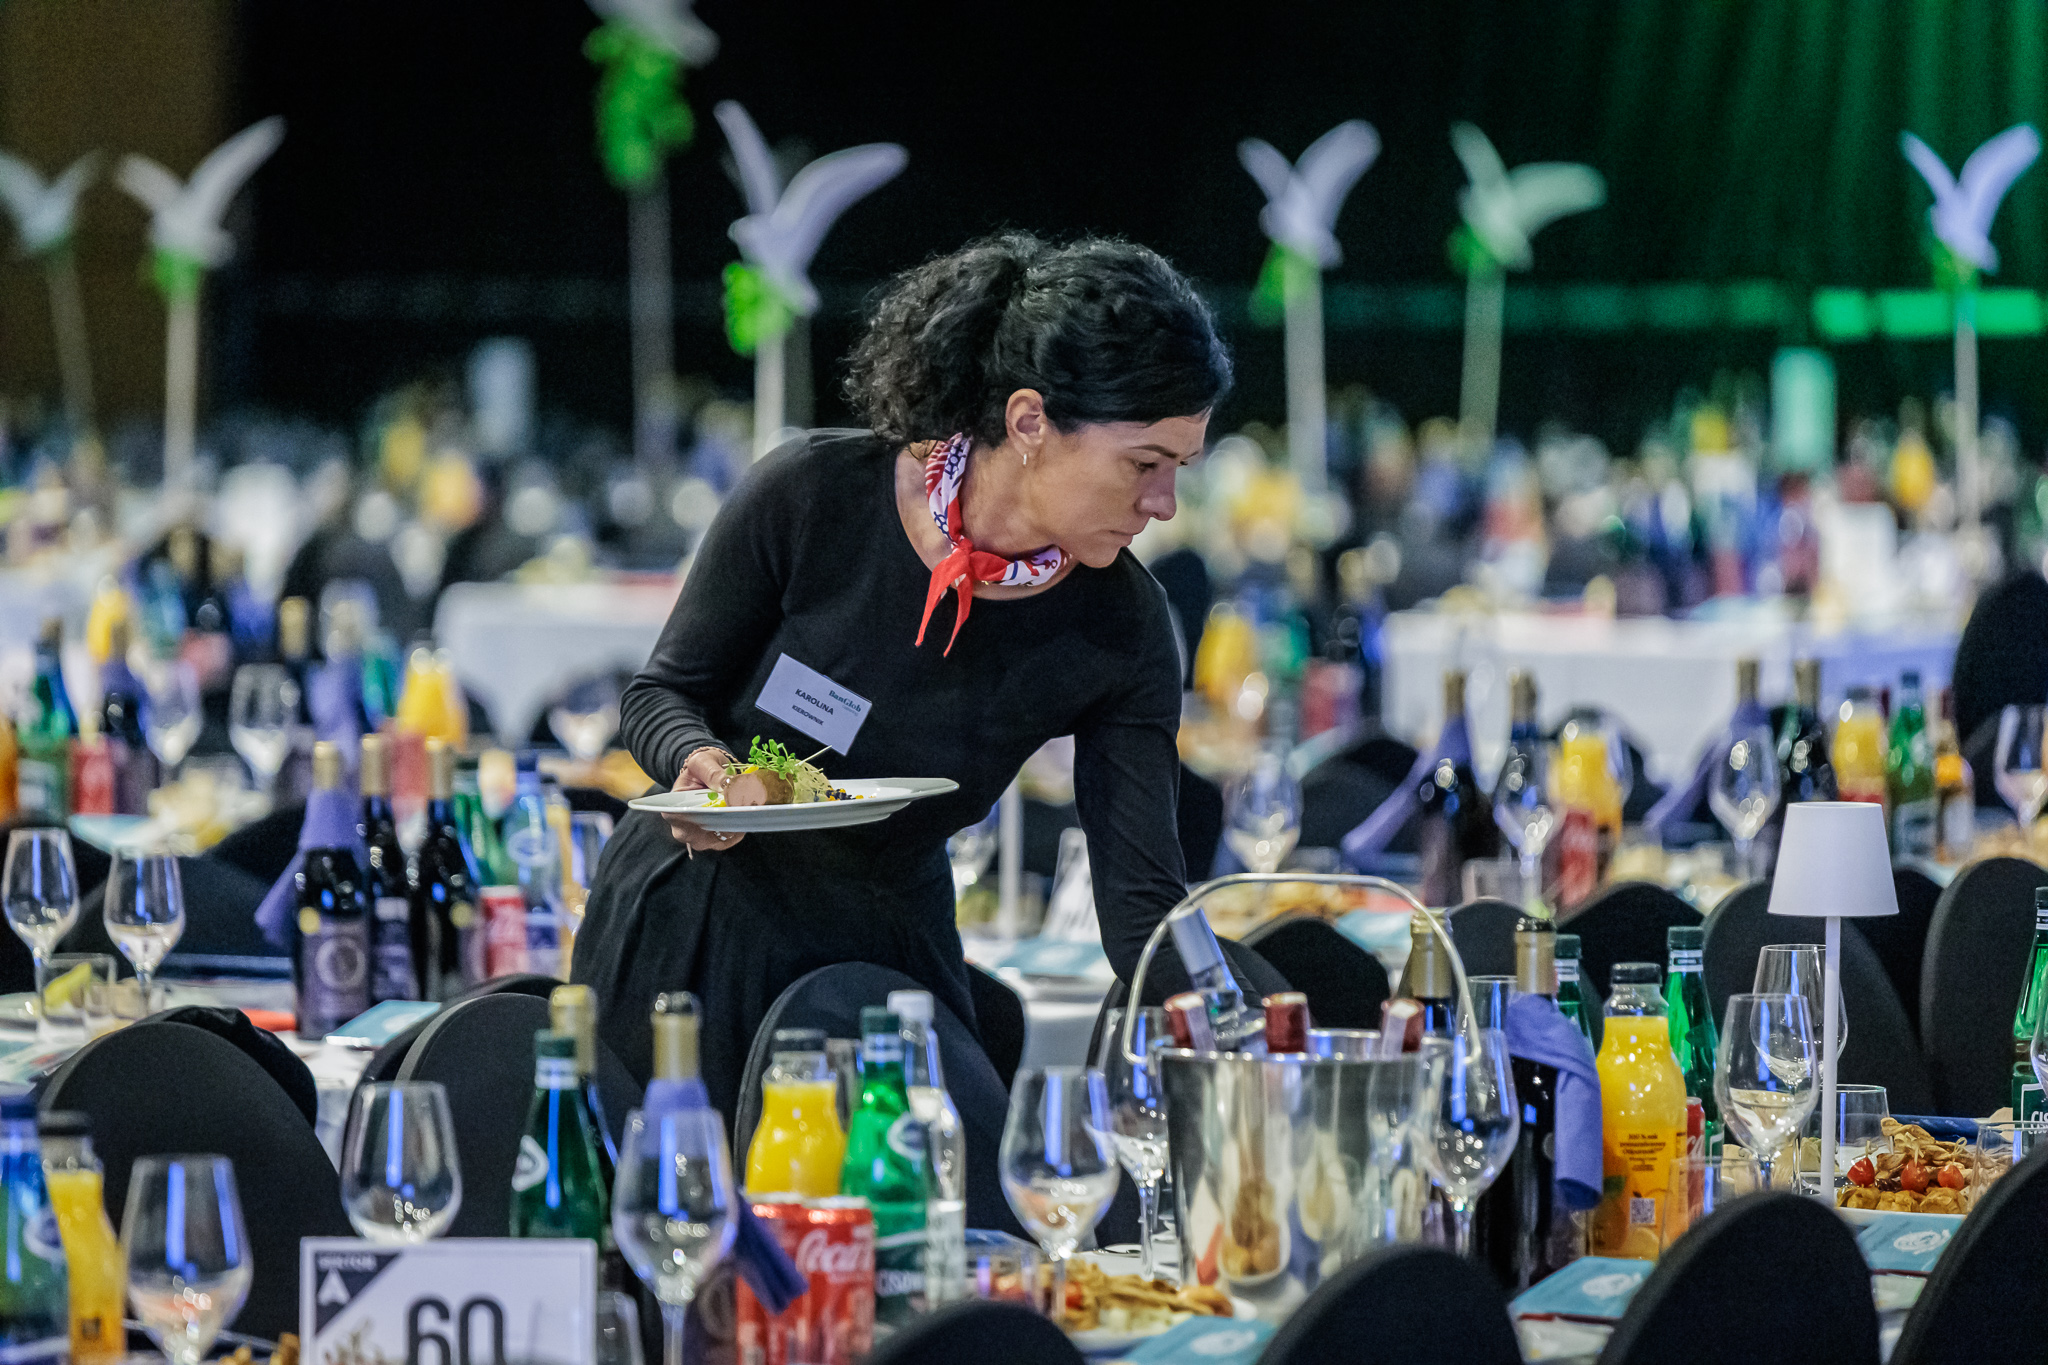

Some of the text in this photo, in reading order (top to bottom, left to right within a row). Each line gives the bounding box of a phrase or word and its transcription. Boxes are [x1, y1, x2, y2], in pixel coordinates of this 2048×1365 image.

[795, 688, 834, 716] KAROLINA
[828, 690, 862, 713] BanGlob
[791, 704, 825, 726] KIEROWNIK
[408, 1296, 505, 1365] 60
